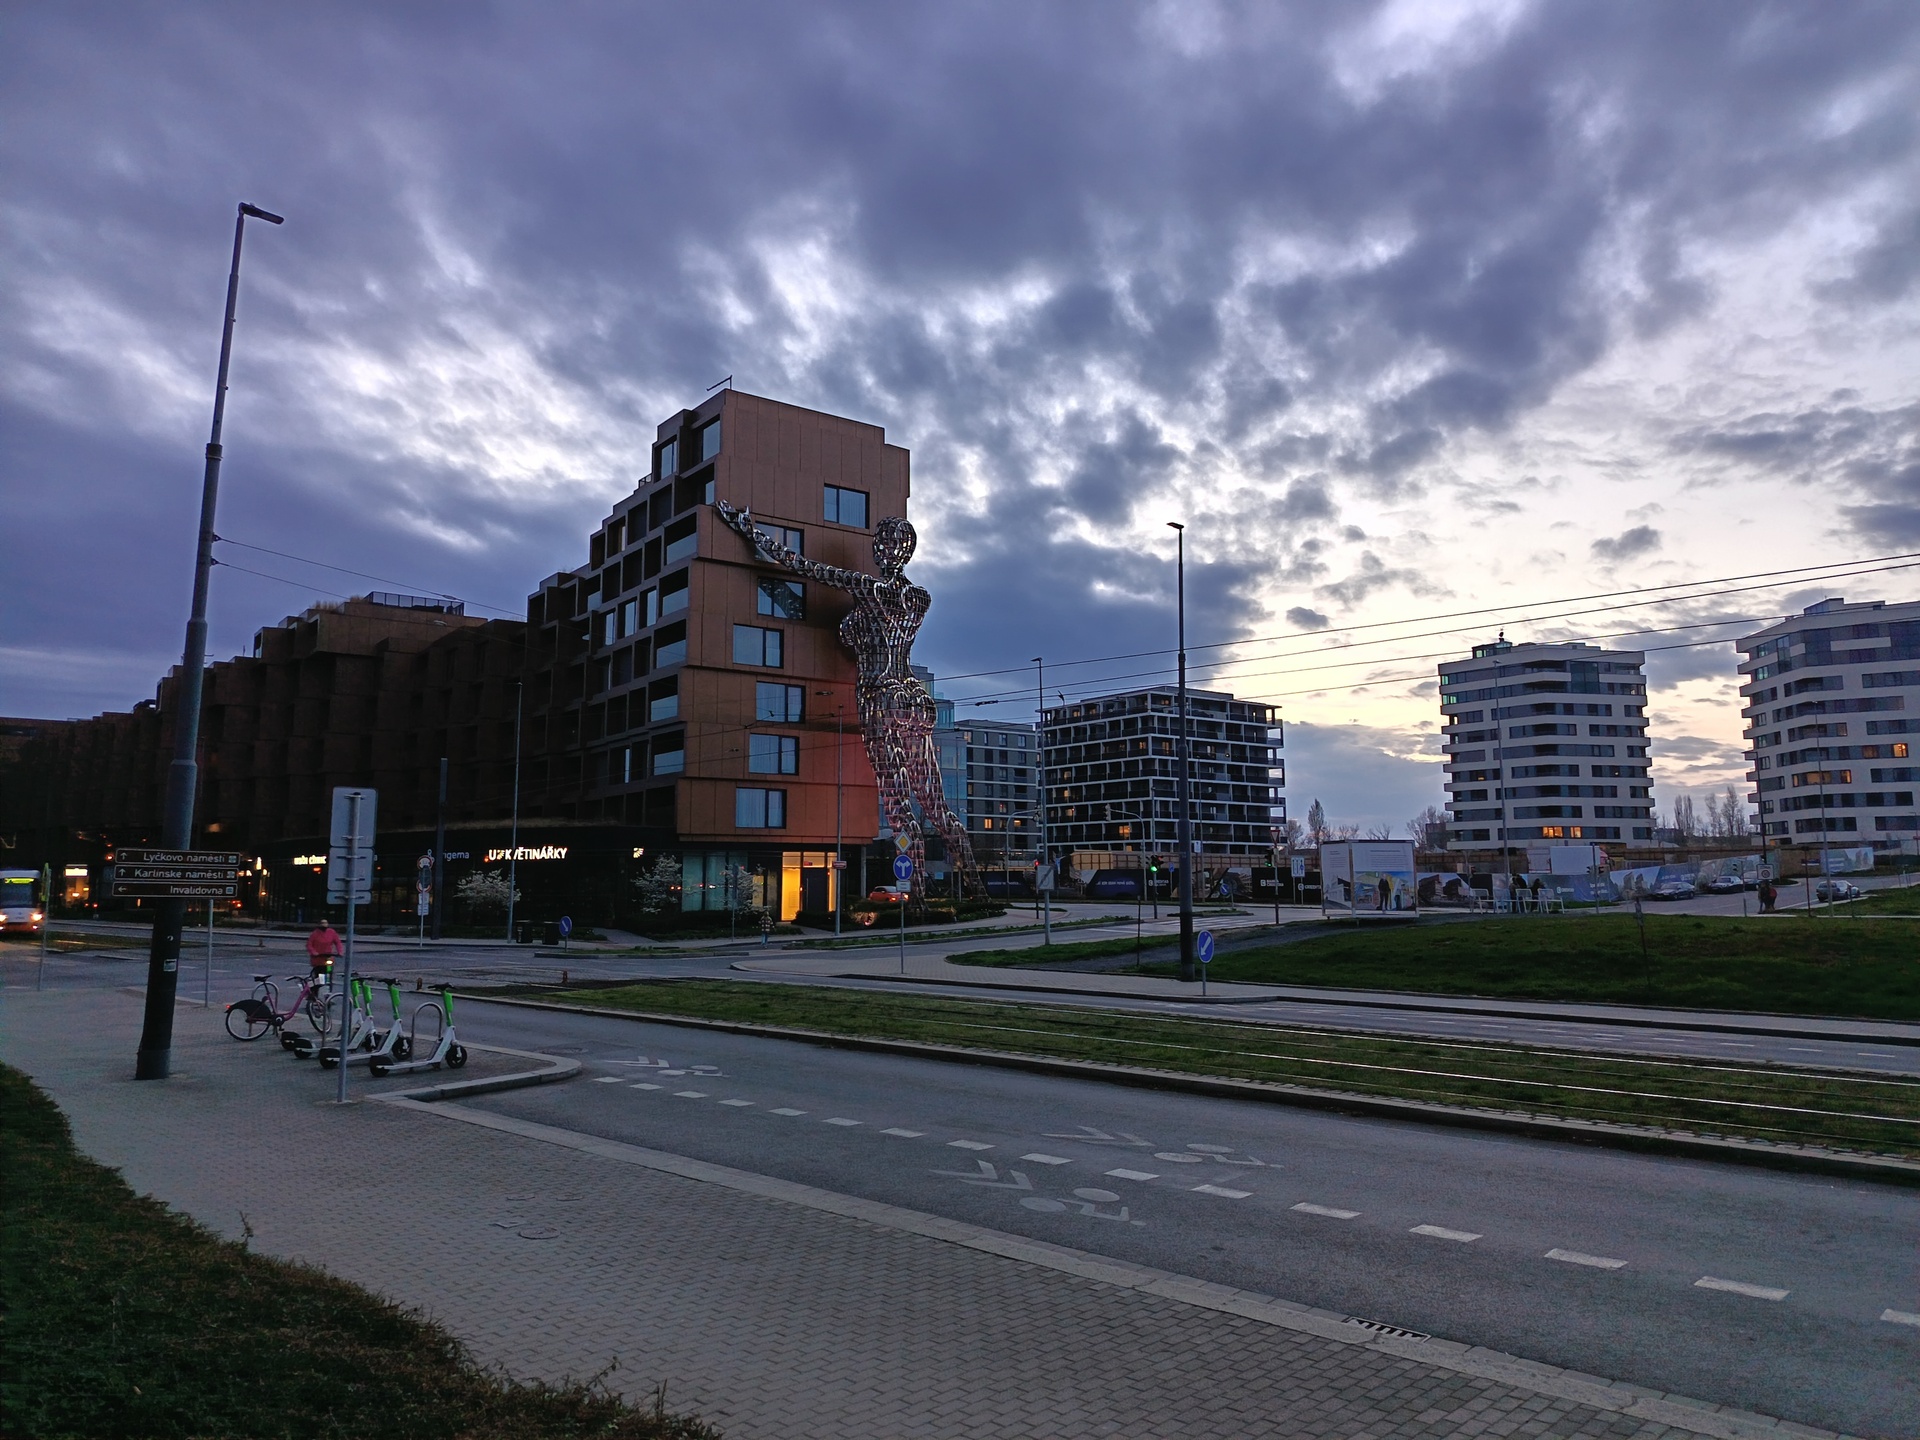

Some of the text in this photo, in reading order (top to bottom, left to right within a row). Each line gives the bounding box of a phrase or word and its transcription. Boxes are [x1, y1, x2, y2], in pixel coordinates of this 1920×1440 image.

[143, 852, 225, 863] Lyčkovo náměstí
[488, 849, 496, 861] U
[134, 868, 224, 879] Karlínské náměstí
[170, 885, 223, 895] Invalidovna
